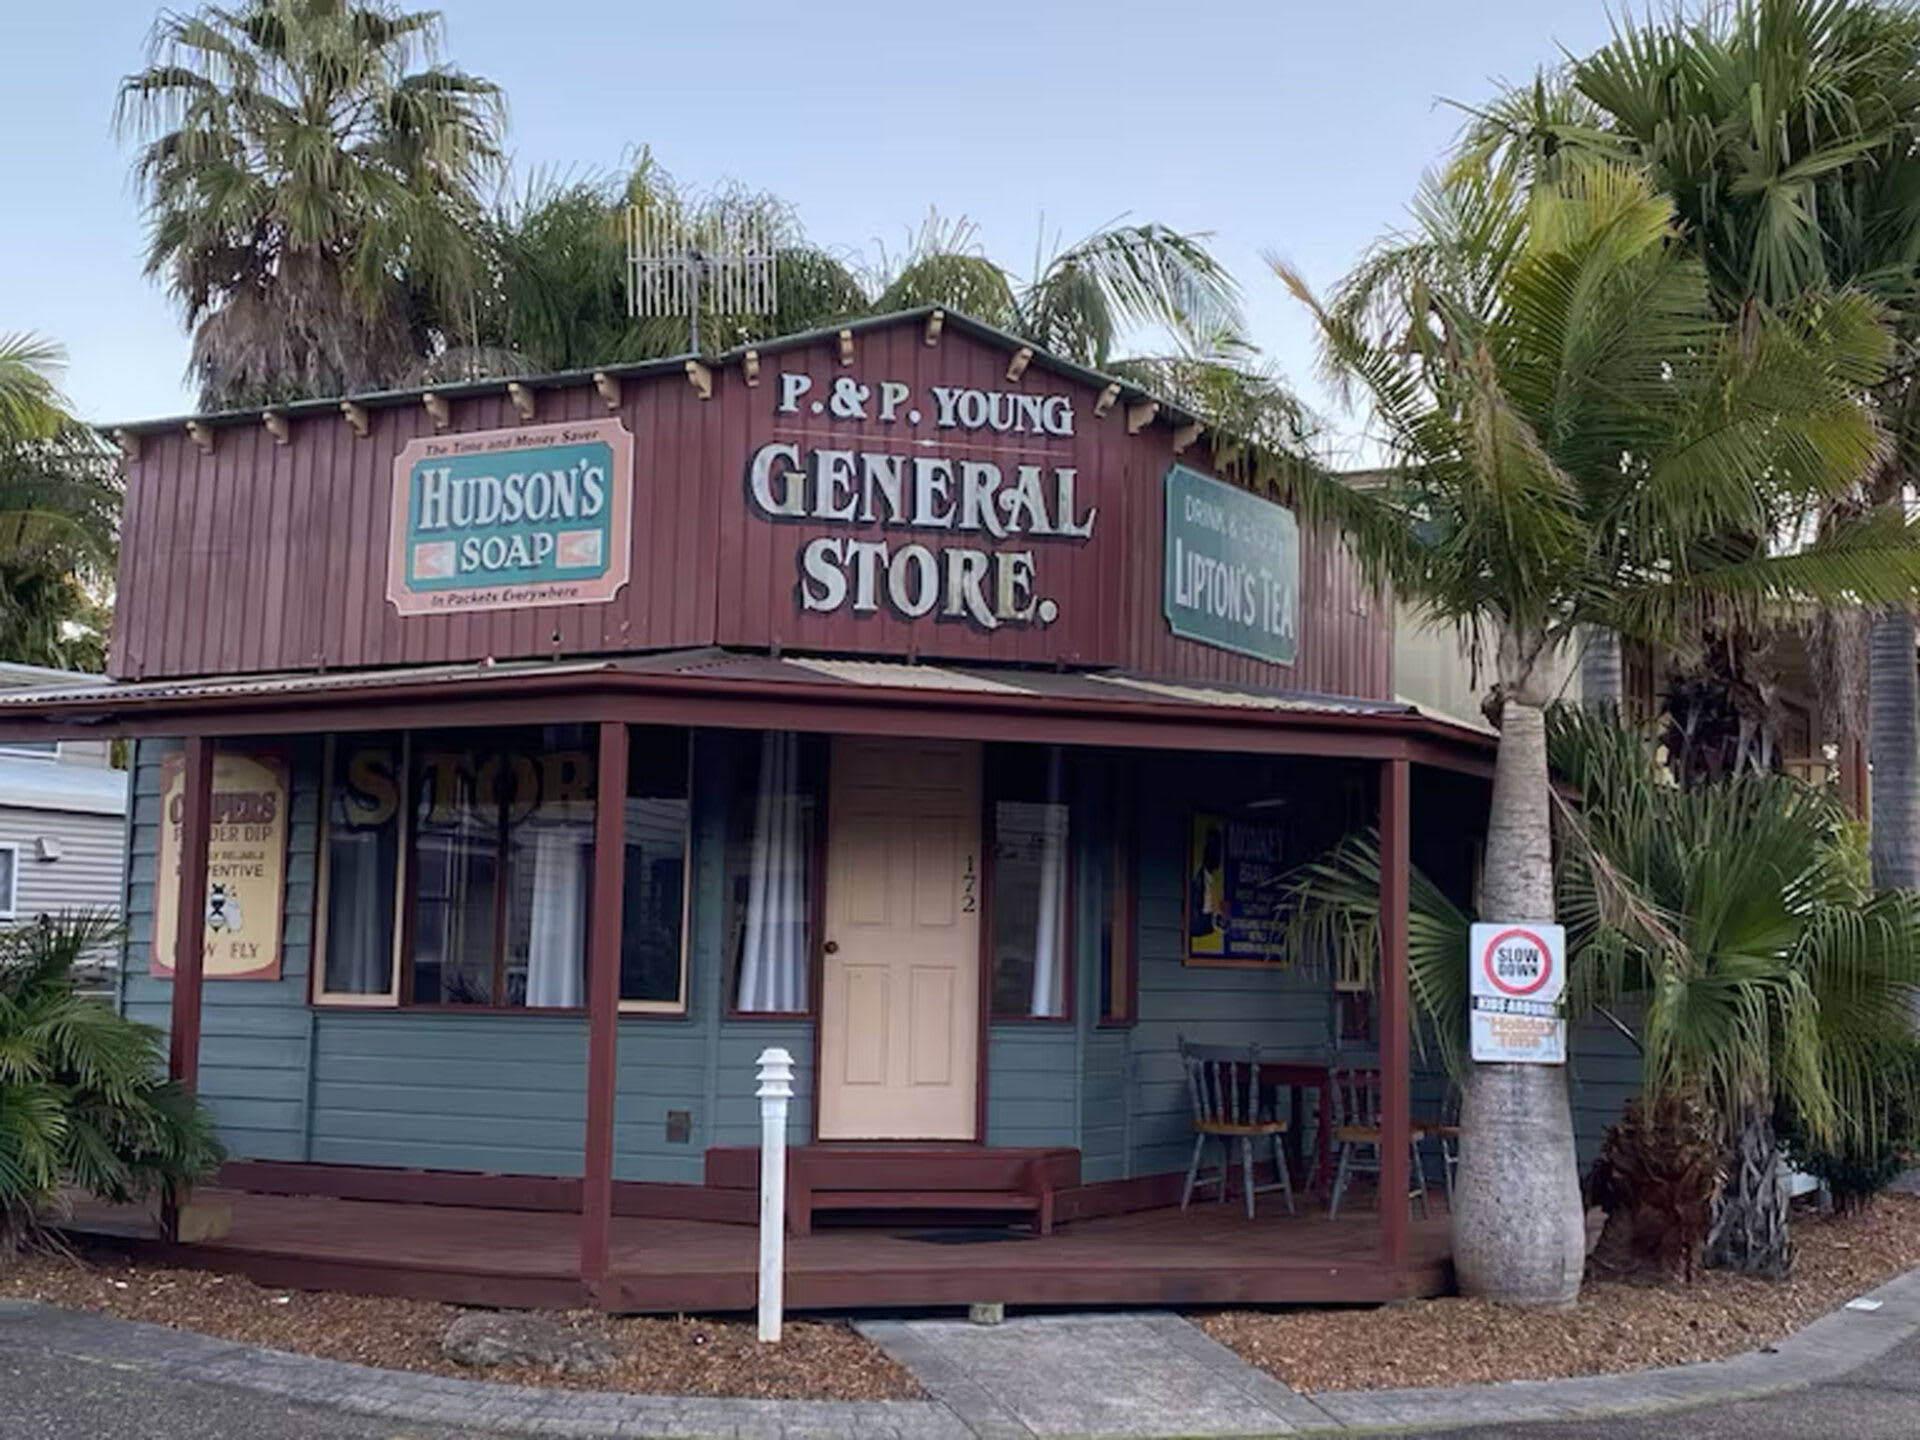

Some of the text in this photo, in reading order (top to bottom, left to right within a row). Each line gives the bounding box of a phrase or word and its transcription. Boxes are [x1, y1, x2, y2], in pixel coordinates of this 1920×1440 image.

[779, 373, 1076, 436] P. & P. YOUNG
[426, 429, 599, 456] The Time and Money Saver
[419, 458, 605, 530] HUDSON'S
[750, 442, 1097, 541] GENERAL
[1184, 494, 1226, 535] DRINK
[460, 532, 554, 572] SOAP
[431, 595, 445, 607] In
[502, 586, 579, 602] Everywhere
[801, 537, 1059, 630] STORE.
[1260, 567, 1295, 639] TEA
[244, 825, 274, 842] DIP
[962, 855, 977, 913] 172
[230, 942, 260, 959] FLY
[1497, 947, 1539, 963] SLOW
[1497, 963, 1539, 977] DOWN
